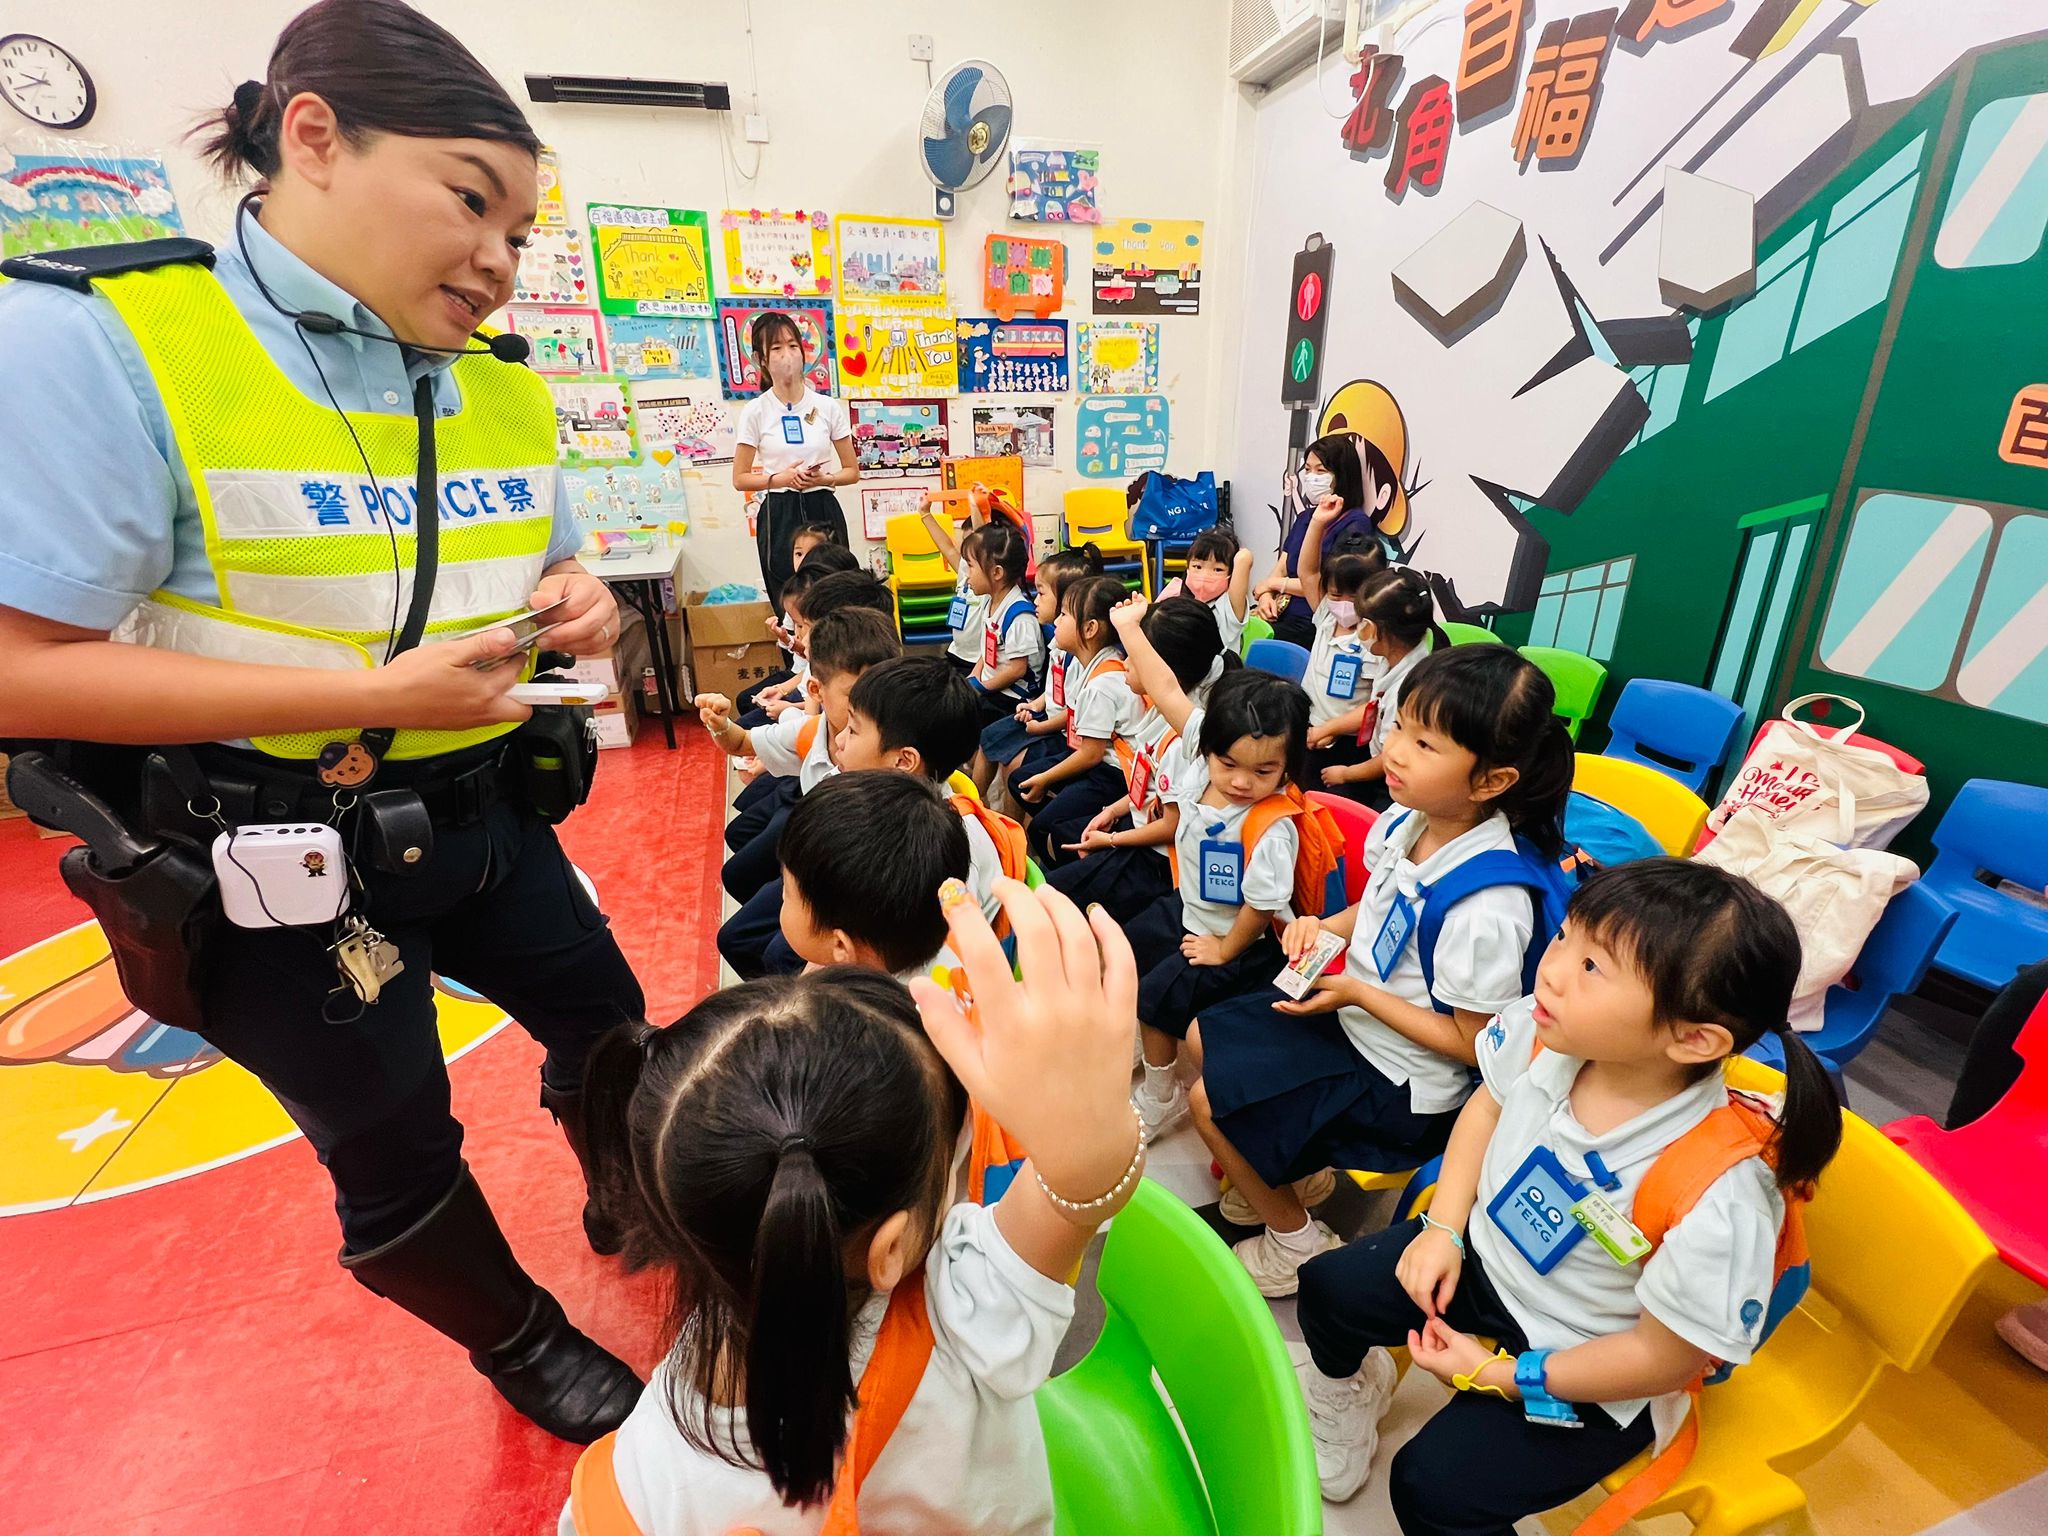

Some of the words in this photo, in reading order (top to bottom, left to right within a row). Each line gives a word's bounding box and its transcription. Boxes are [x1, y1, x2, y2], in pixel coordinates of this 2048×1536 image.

[619, 245, 662, 264] Thank
[915, 329, 954, 347] Thank
[301, 481, 350, 525] 警
[359, 478, 498, 526] POICE
[498, 477, 536, 512] 察
[1208, 876, 1236, 888] TEKG
[1514, 1196, 1552, 1244] TEKG
